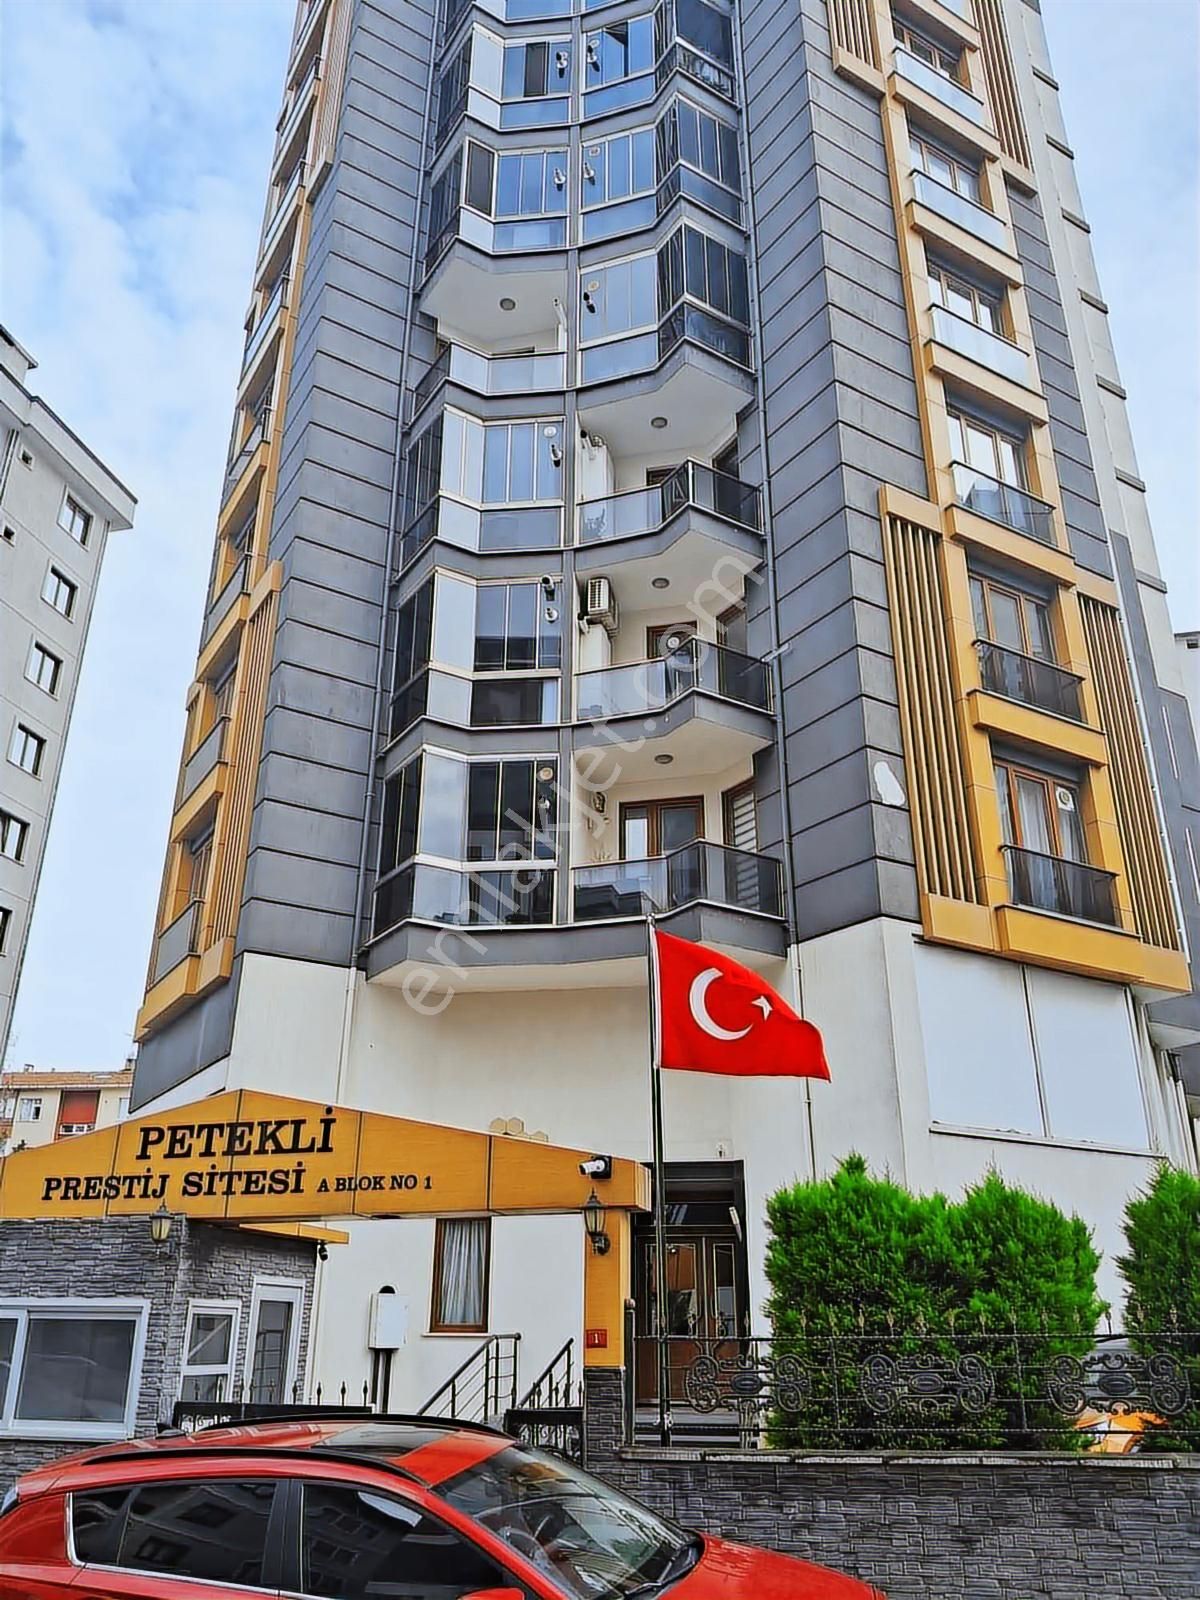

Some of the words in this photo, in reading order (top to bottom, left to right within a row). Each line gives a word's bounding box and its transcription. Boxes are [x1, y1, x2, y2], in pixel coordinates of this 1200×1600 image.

[135, 1106, 337, 1160] PETEKLİ
[41, 1168, 170, 1200] PRESTİJ
[181, 1161, 306, 1196] SİTESİ
[316, 1178, 330, 1192] A
[334, 1176, 386, 1192] BLOK
[389, 1174, 418, 1190] NO
[424, 1175, 432, 1190] 1
